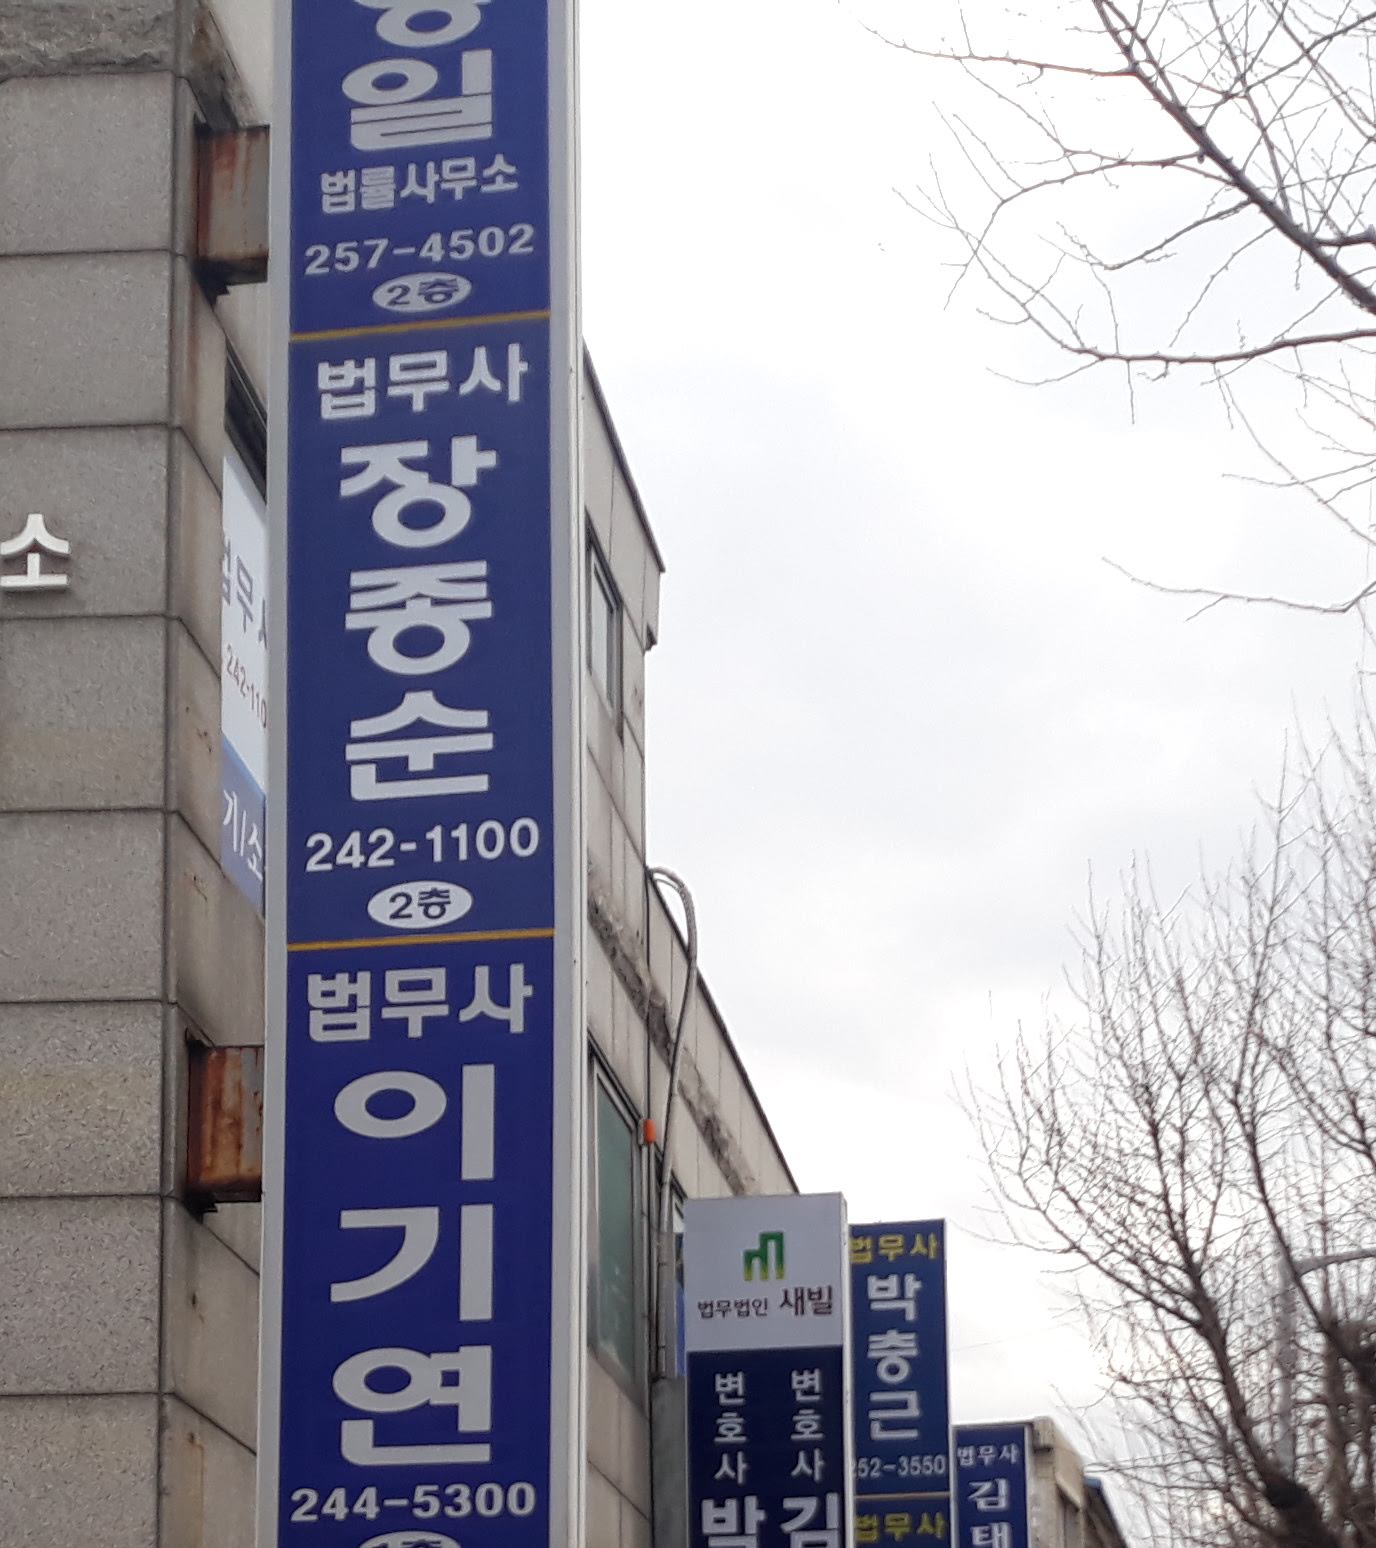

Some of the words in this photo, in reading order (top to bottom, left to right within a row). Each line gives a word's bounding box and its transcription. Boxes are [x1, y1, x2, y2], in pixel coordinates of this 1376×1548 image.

[320, 153, 519, 214] 법률사무소
[304, 223, 534, 275] 257-4502
[386, 277, 459, 307] 2층
[317, 343, 528, 420] 법무사
[339, 435, 498, 801] 장종순
[305, 817, 541, 873] 242-1100
[389, 887, 453, 921] 2층
[306, 962, 534, 1044] 법무사
[329, 1064, 496, 1467] 이기연
[849, 1233, 938, 1263] 법무사
[697, 1298, 769, 1320] 법무법인
[779, 1285, 834, 1317] 새빌
[866, 1274, 923, 1442] 박충근
[714, 1369, 749, 1486] 변호사
[790, 1367, 825, 1482] 변호사
[853, 1455, 946, 1479] 52-3550
[957, 1443, 1020, 1467] 법무사
[289, 1481, 537, 1523] 244-5300
[856, 1512, 945, 1543] 법무사
